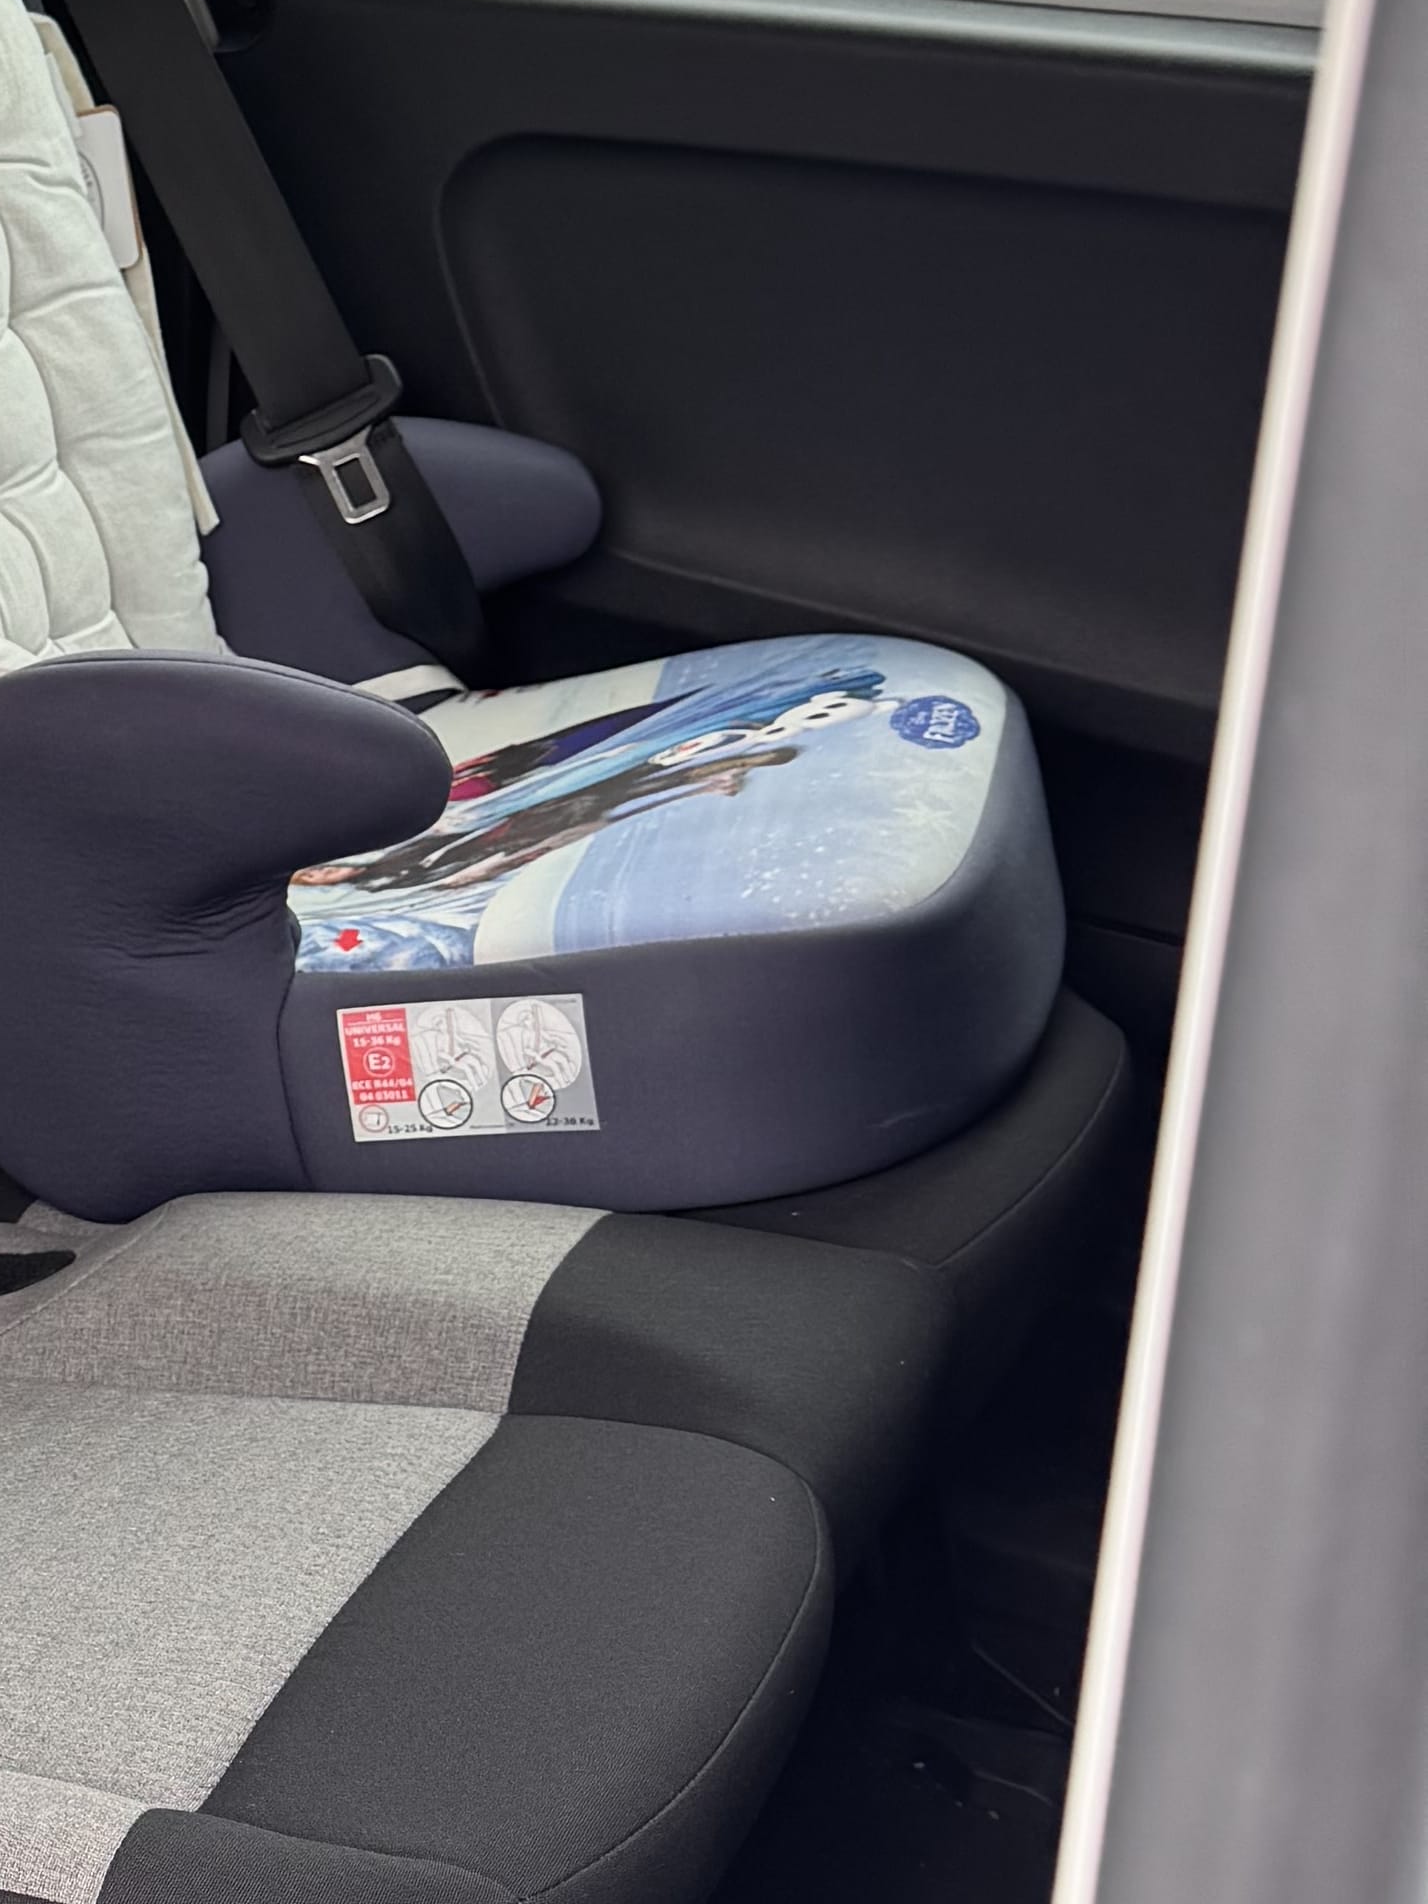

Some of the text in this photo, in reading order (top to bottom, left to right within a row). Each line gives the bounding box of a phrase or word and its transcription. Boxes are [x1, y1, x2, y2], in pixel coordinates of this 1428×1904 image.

[344, 1022, 405, 1036] UNIVERSAL
[368, 1053, 391, 1070] E2
[388, 1122, 418, 1135] 15-25
